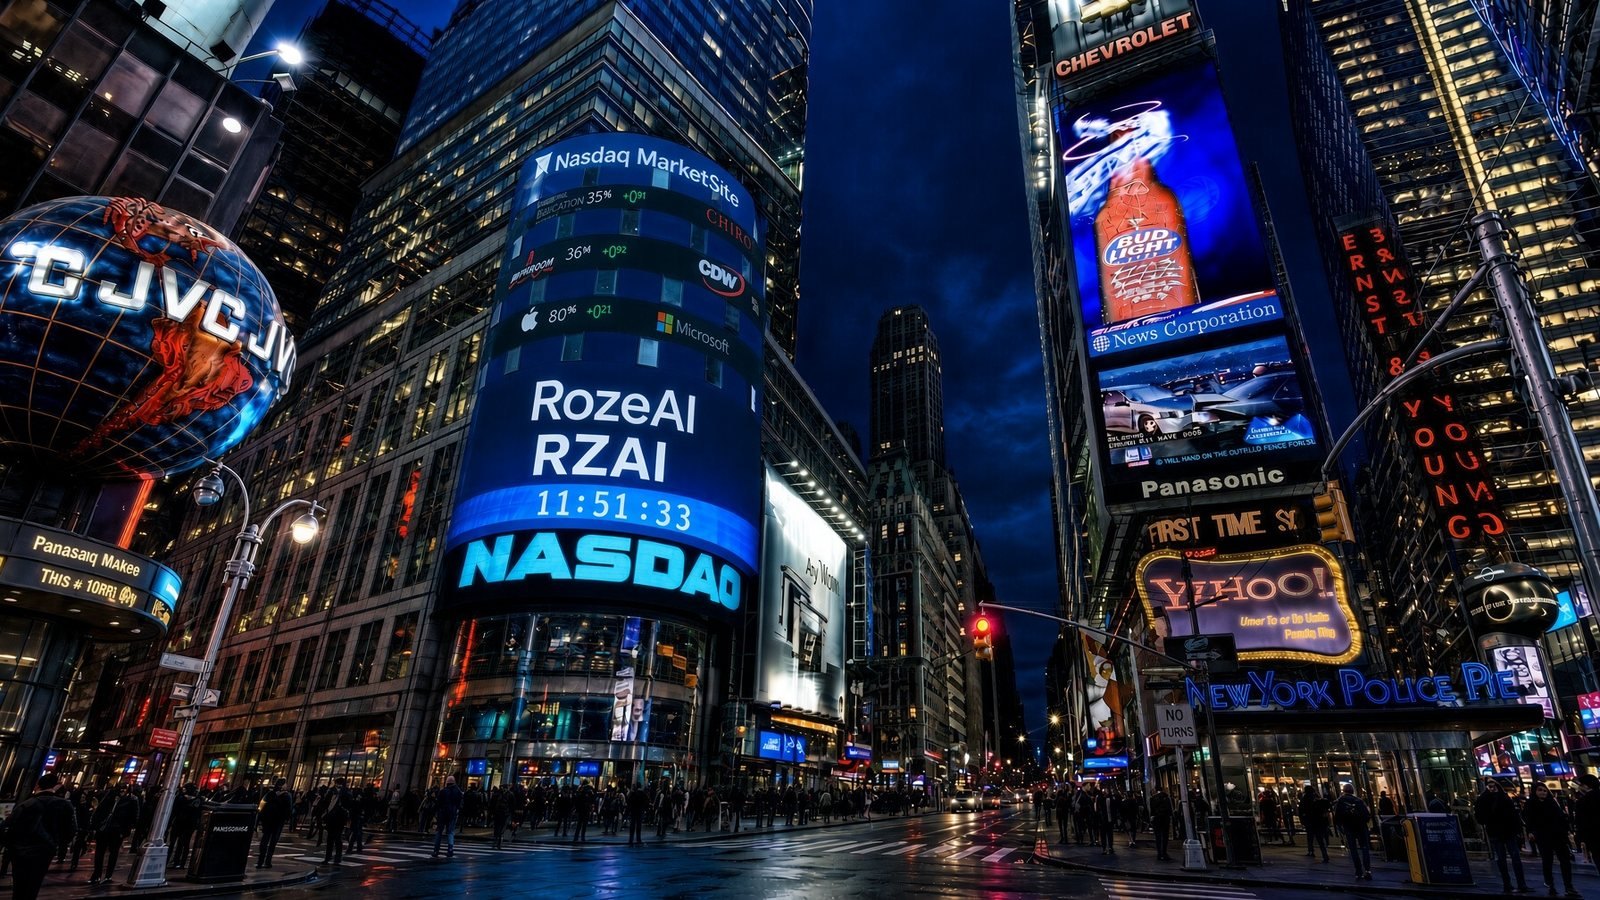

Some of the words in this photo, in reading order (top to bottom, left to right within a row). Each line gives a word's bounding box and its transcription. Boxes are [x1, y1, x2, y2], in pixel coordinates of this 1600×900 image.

[1056, 12, 1193, 77] CHEVROLET
[555, 147, 630, 171] Nasdaq
[637, 148, 739, 207] MarketSite
[706, 208, 752, 250] CHIRO
[1117, 229, 1169, 249] BUD
[1110, 237, 1178, 264] LIGHT
[698, 259, 738, 289] CDW
[676, 319, 730, 356] Microsoft
[1112, 329, 1159, 348] News
[1164, 303, 1278, 335] Corporation
[1343, 234, 1387, 335] ERNST
[1403, 400, 1470, 539] YOUNG
[531, 379, 696, 434] RozeAI
[532, 433, 667, 482] RZAI
[1142, 467, 1285, 498] Panasonic
[537, 490, 691, 531] 11:51:33
[1211, 510, 1267, 538] TIME
[41, 568, 71, 588] THIS
[1248, 670, 1334, 709] YORK
[1161, 727, 1194, 738] TURNS
[1166, 709, 1184, 721] NO
